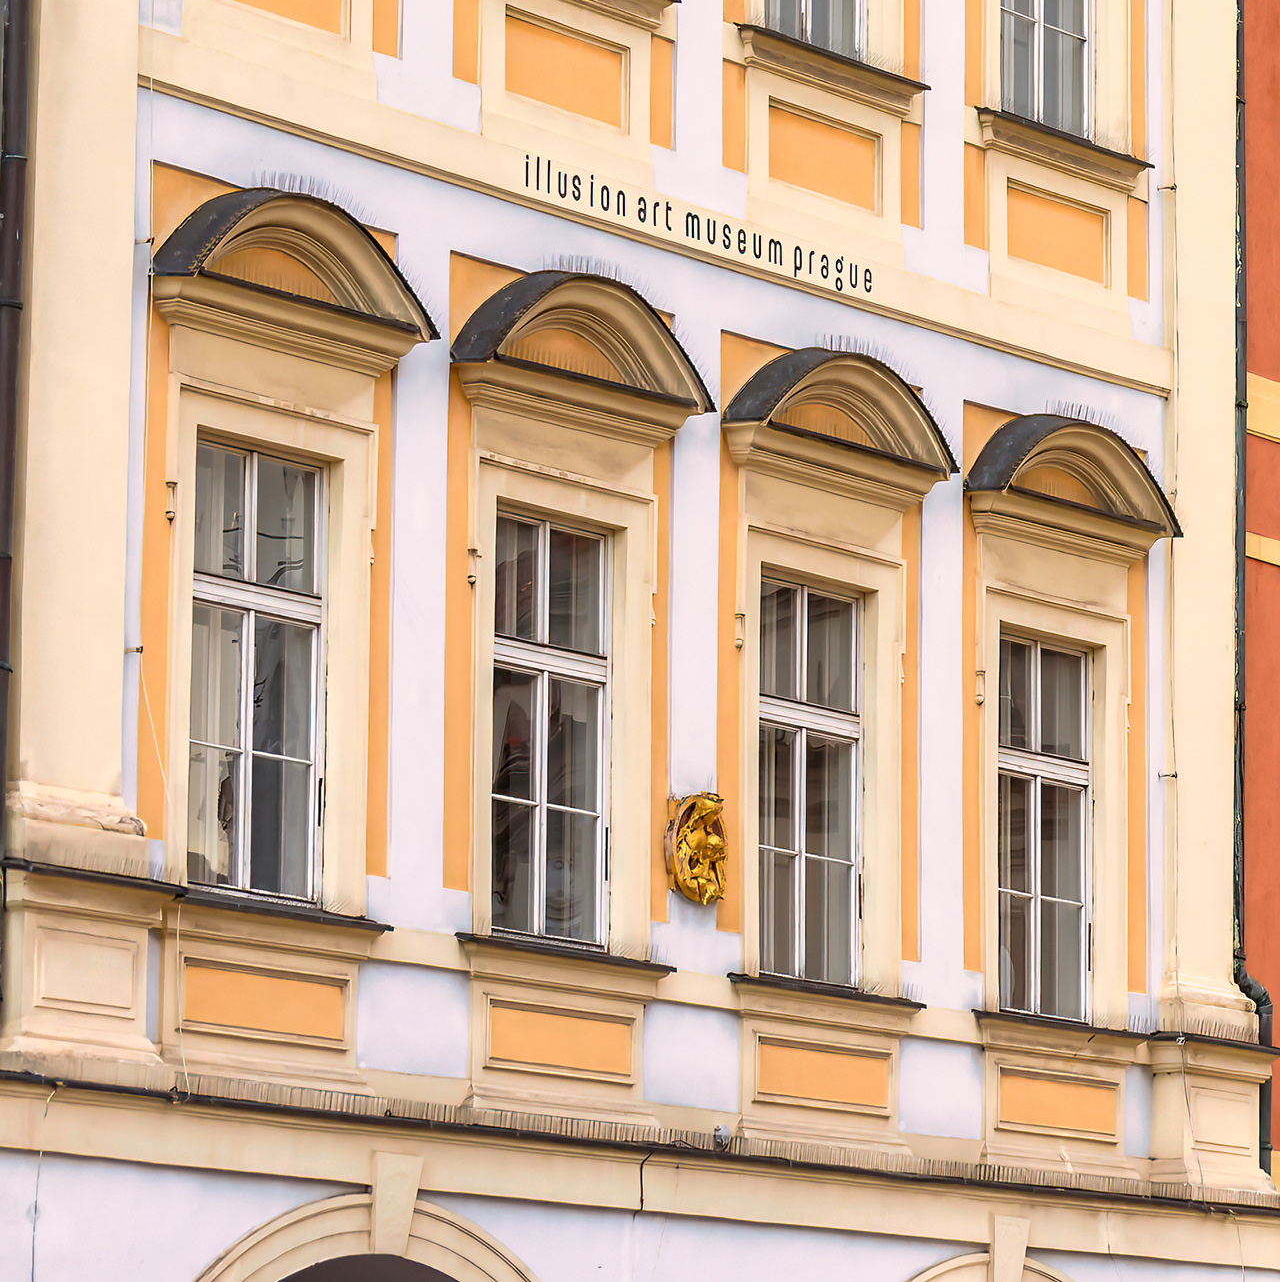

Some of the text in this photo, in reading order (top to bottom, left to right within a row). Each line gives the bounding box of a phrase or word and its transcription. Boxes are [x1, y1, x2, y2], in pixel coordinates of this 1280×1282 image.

[525, 154, 873, 294] illusion art museum prague
